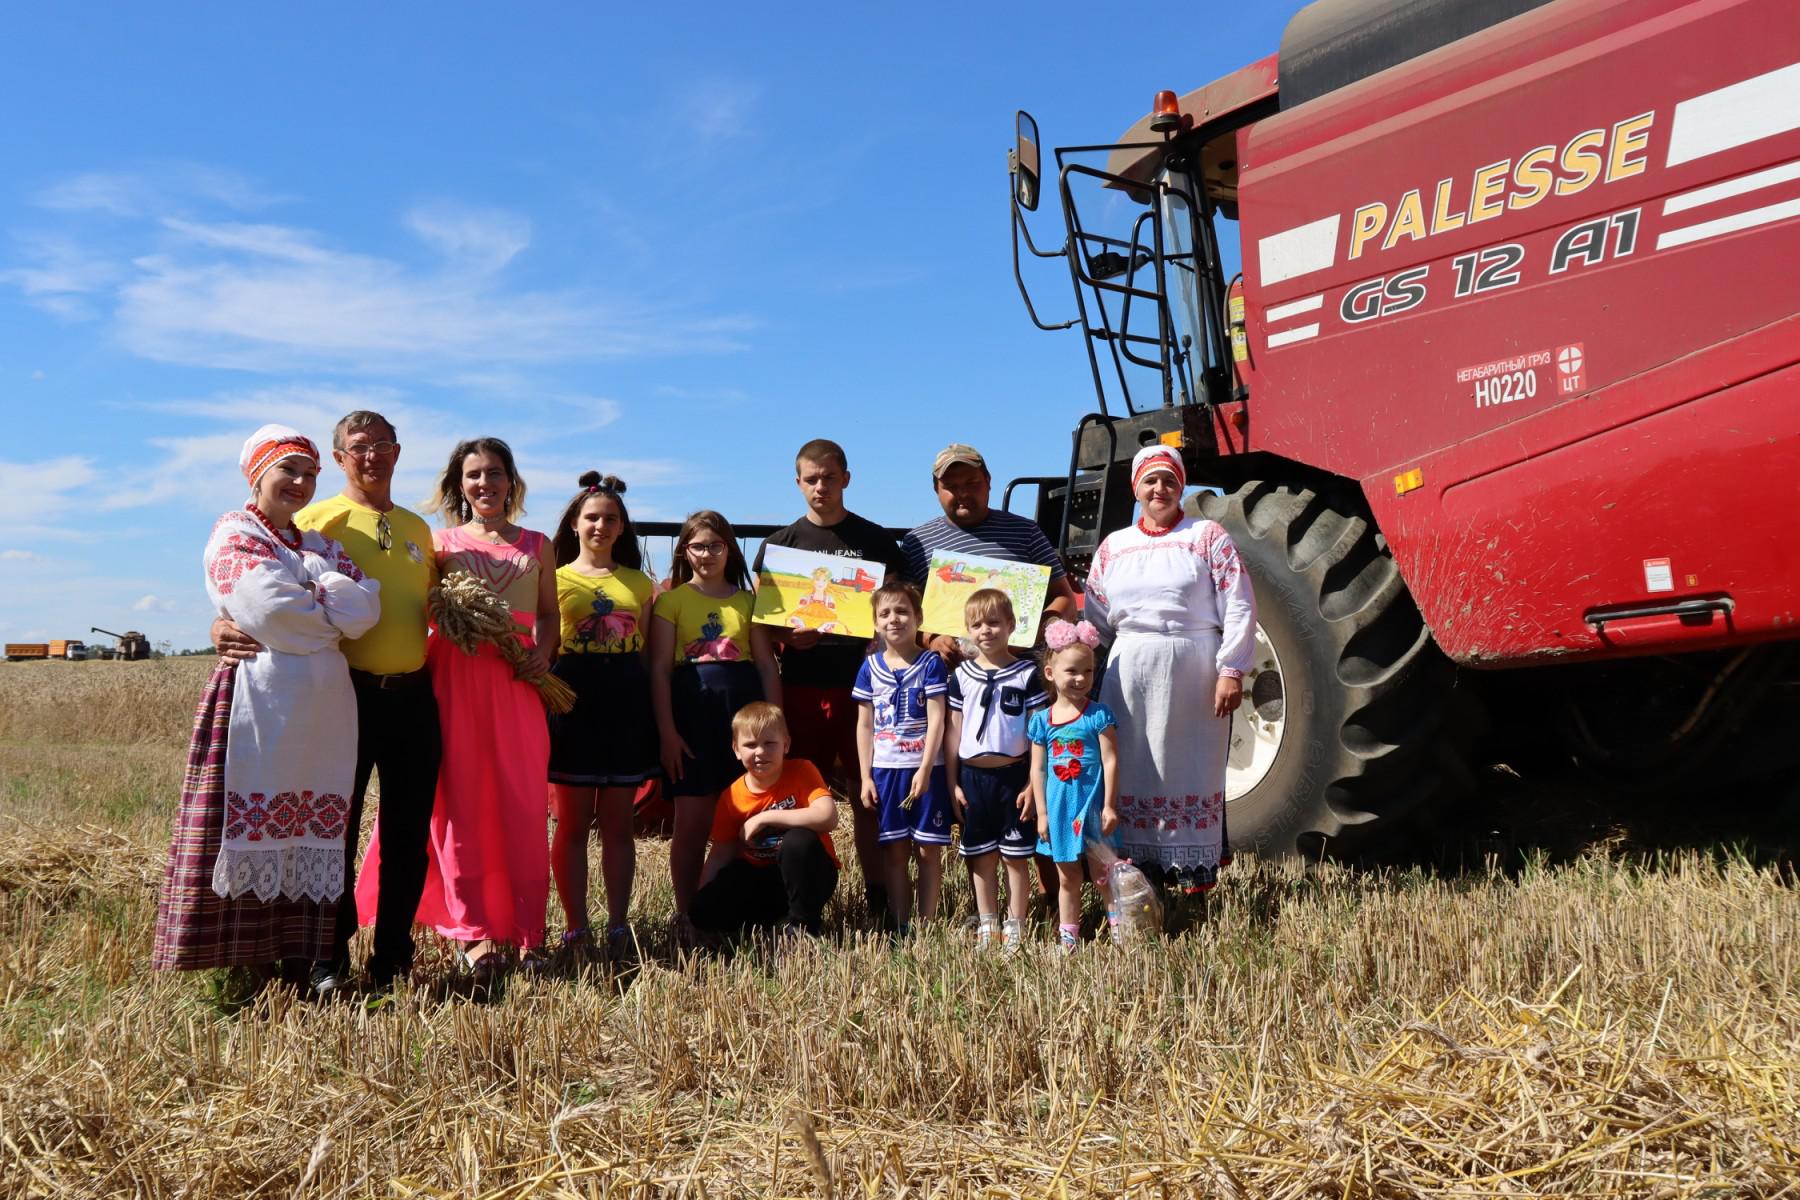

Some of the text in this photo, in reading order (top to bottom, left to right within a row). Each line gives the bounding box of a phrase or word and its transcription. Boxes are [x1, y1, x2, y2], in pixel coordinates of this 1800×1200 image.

[1348, 110, 1655, 261] PALESSE
[1340, 207, 1642, 324] GS 12 A1
[1456, 351, 1551, 383] НЕГАБАРИТНЫЙ ГРУЗ
[1563, 375, 1580, 393] ЦТ
